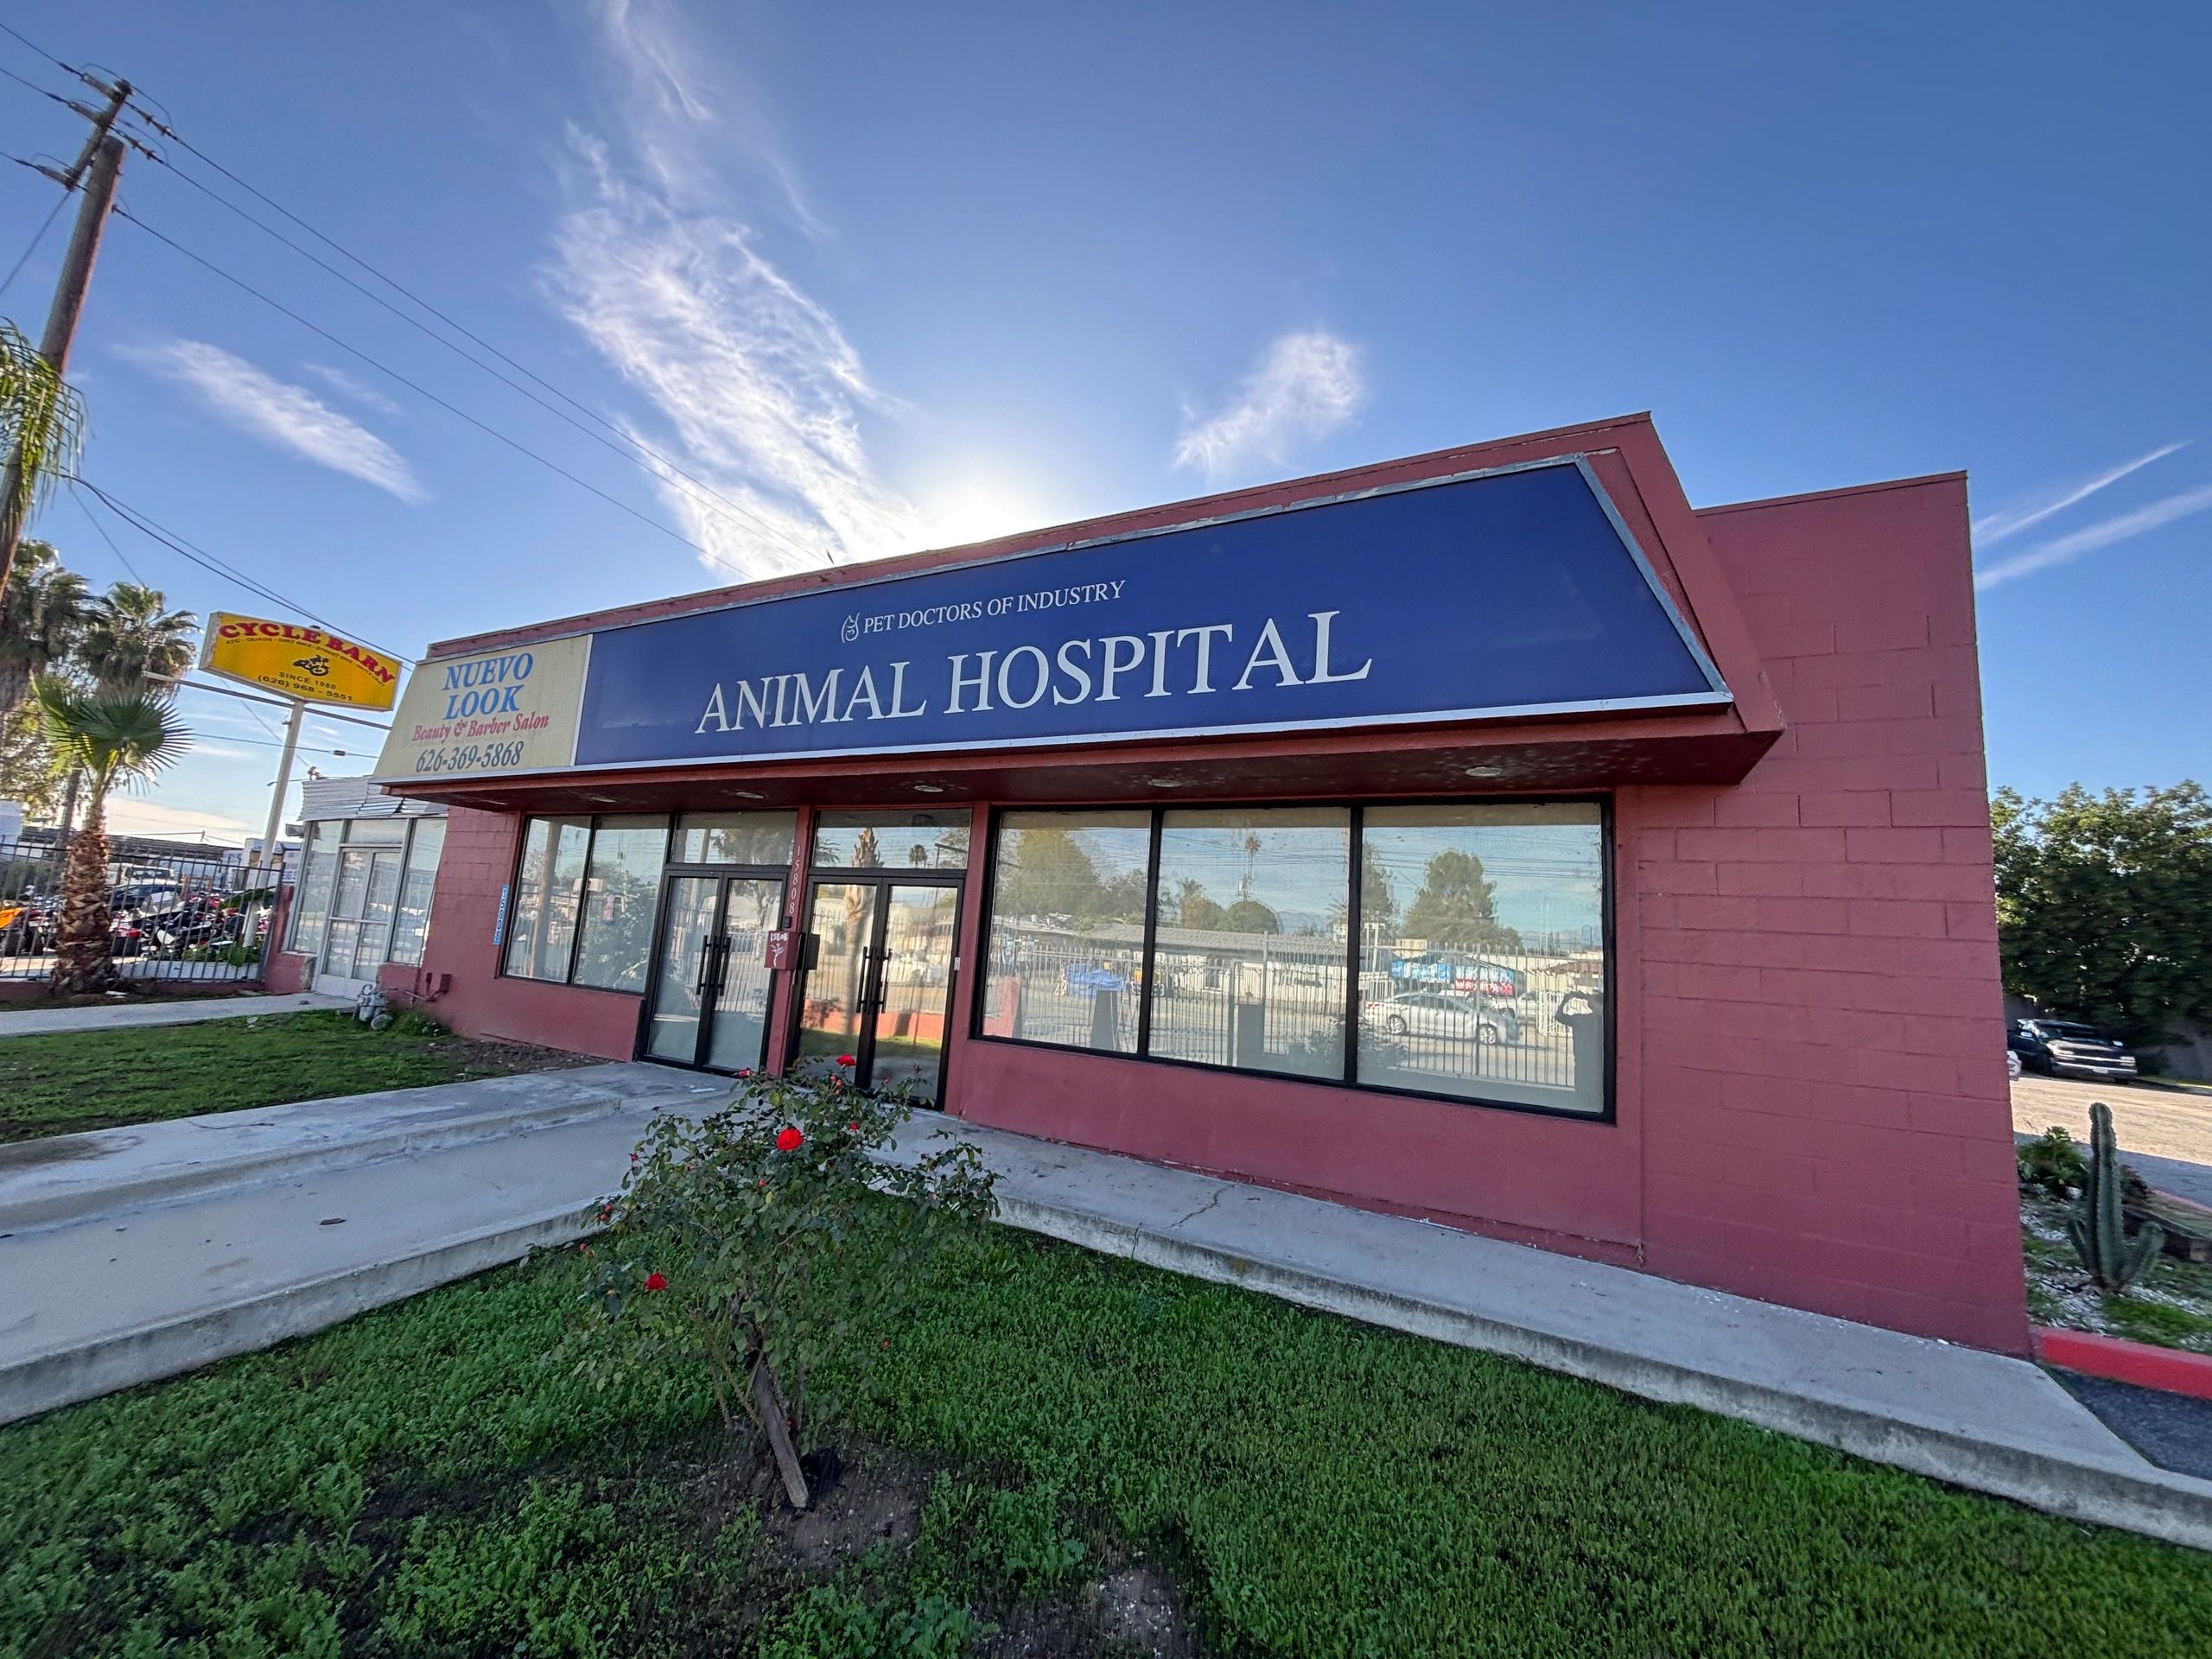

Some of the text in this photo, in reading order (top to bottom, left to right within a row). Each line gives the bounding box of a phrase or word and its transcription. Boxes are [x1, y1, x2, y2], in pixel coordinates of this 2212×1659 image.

[863, 580, 1126, 633] PET DOCTORS OF INDUSTRY
[219, 622, 395, 683] CYCLE BARN
[442, 652, 533, 690] NUEVO
[257, 674, 289, 688] (626)
[293, 683, 315, 692] 968
[326, 690, 353, 702] 5551
[279, 671, 336, 690] SINCE 1980
[694, 610, 1372, 734] ANIMAL HOSPITAL
[442, 684, 524, 720] LOOK
[411, 711, 550, 743] Beauty & Barber Salon
[416, 741, 524, 772] 626-369-5868
[789, 845, 801, 914] 15808
